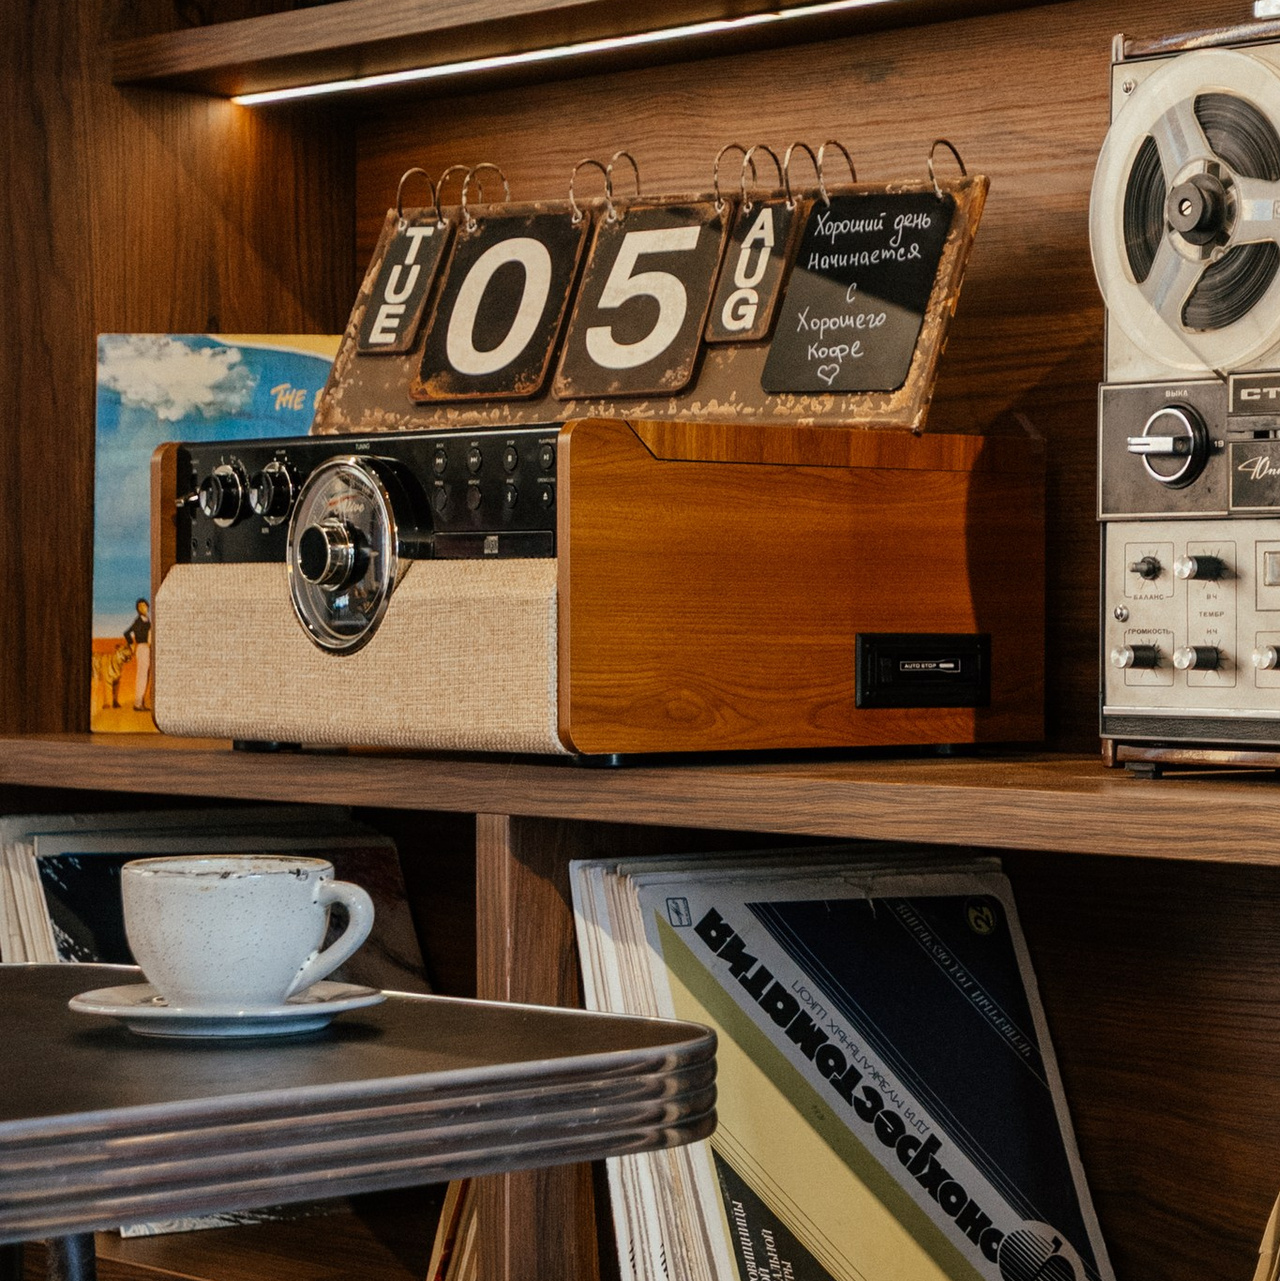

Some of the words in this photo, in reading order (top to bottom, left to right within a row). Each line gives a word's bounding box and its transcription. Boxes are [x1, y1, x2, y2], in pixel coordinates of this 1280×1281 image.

[814, 210, 887, 245] Хороший
[889, 212, 932, 247] день
[368, 226, 435, 345] TUE
[721, 207, 774, 332] AUG
[796, 305, 887, 340] Хорошего
[269, 382, 308, 412] THE
[1133, 593, 1164, 601] БАЛАНС
[1199, 610, 1225, 618] ТЕМБР
[1127, 627, 1171, 636] ГРОМКОСТЬ
[1206, 627, 1218, 635] НЧ
